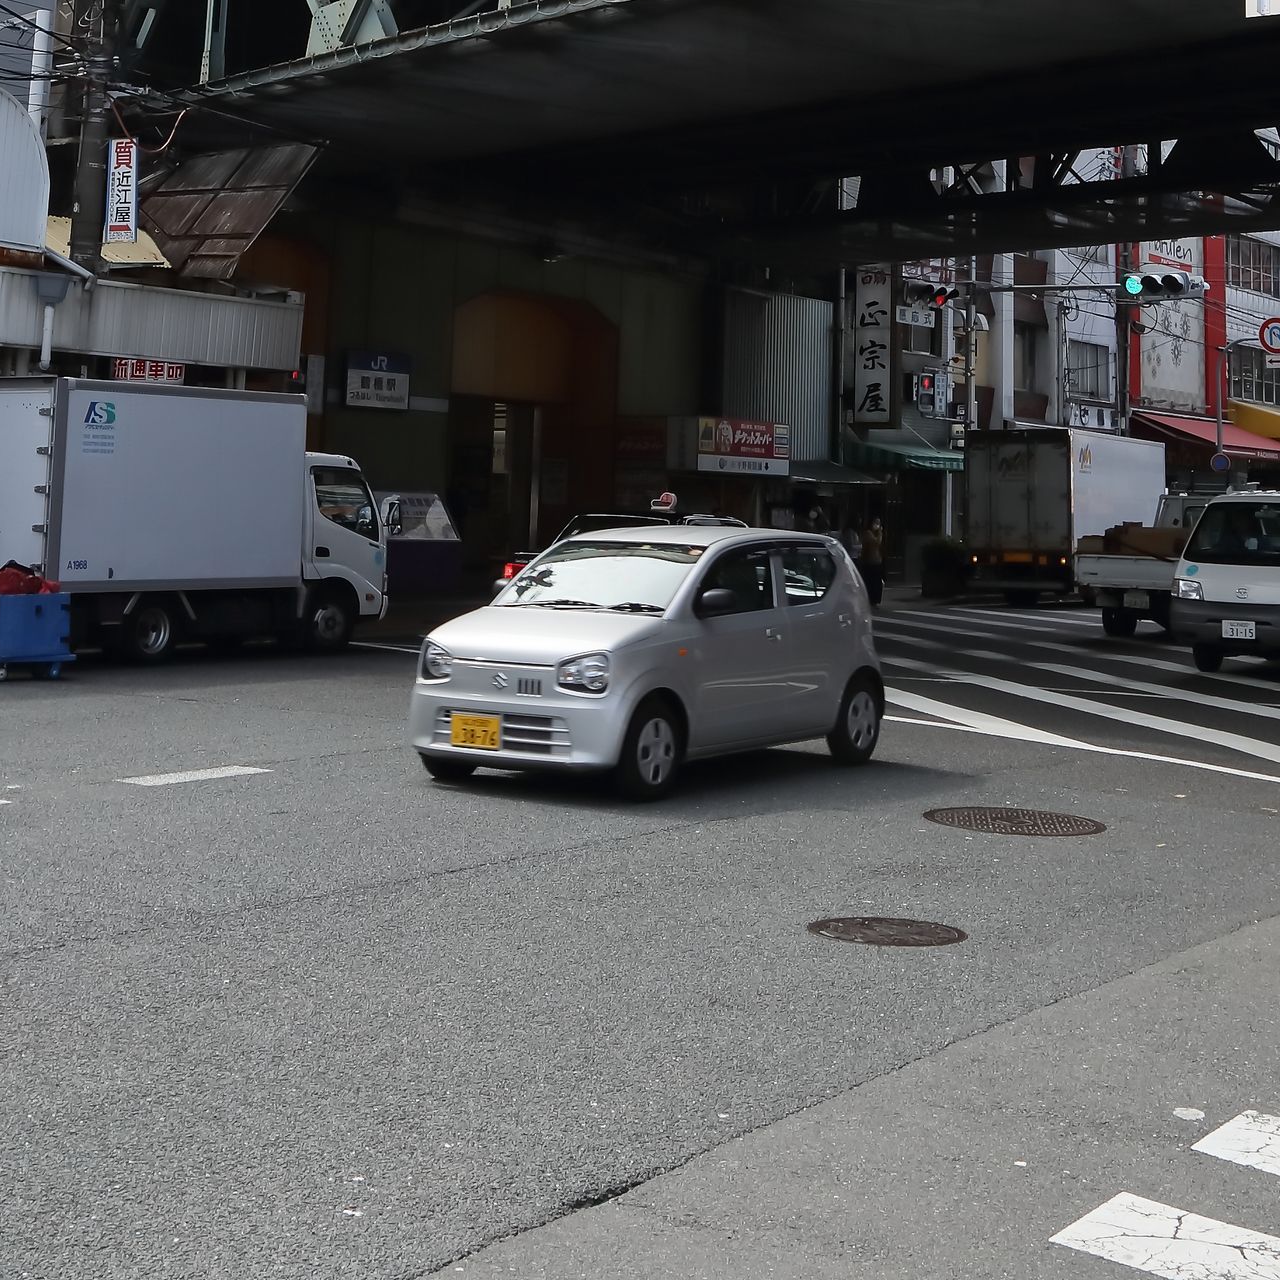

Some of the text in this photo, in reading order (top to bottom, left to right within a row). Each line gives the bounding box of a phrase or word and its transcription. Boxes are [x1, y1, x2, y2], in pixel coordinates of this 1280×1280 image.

[113, 141, 133, 170] 質
[114, 170, 132, 223] 近江屋
[371, 355, 388, 370] JR
[857, 300, 888, 414] 正宗屋
[1229, 627, 1254, 638] 31-15
